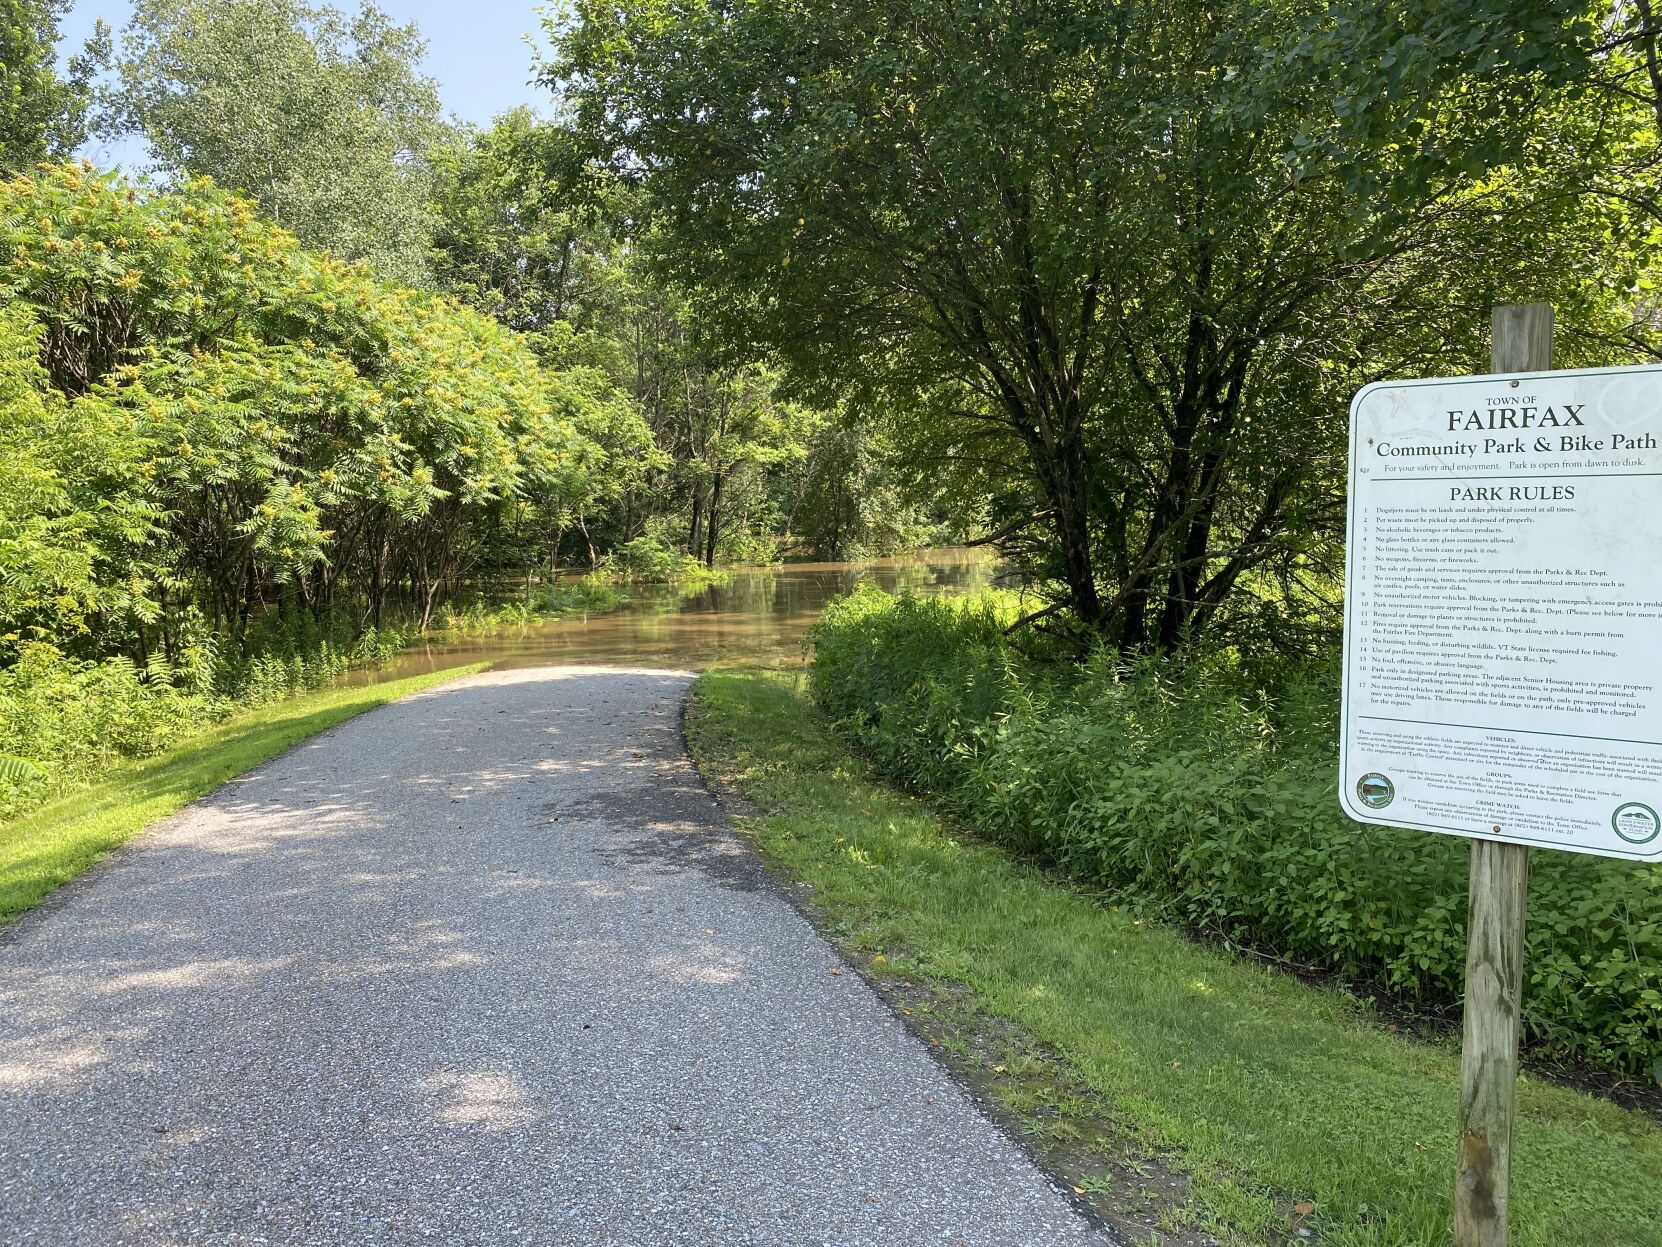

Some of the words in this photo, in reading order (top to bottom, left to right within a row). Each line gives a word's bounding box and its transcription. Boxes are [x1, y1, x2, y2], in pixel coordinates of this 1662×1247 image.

[1486, 396, 1519, 405] TOWN
[1522, 395, 1536, 403] OF
[1446, 404, 1586, 430] FAIRFAX
[1376, 441, 1477, 457] Community
[1484, 437, 1526, 453] Park
[1534, 437, 1554, 452] &
[1560, 435, 1604, 451] Bike
[1611, 433, 1658, 449] Path
[1398, 466, 1416, 474] your
[1417, 464, 1439, 473] safety
[1456, 463, 1502, 473] enjoyment.
[1538, 462, 1560, 471] open
[1623, 458, 1646, 466] dusk.
[1450, 487, 1503, 500] PARK
[1509, 486, 1575, 500] RULES
[1440, 641, 1471, 650] disturbing
